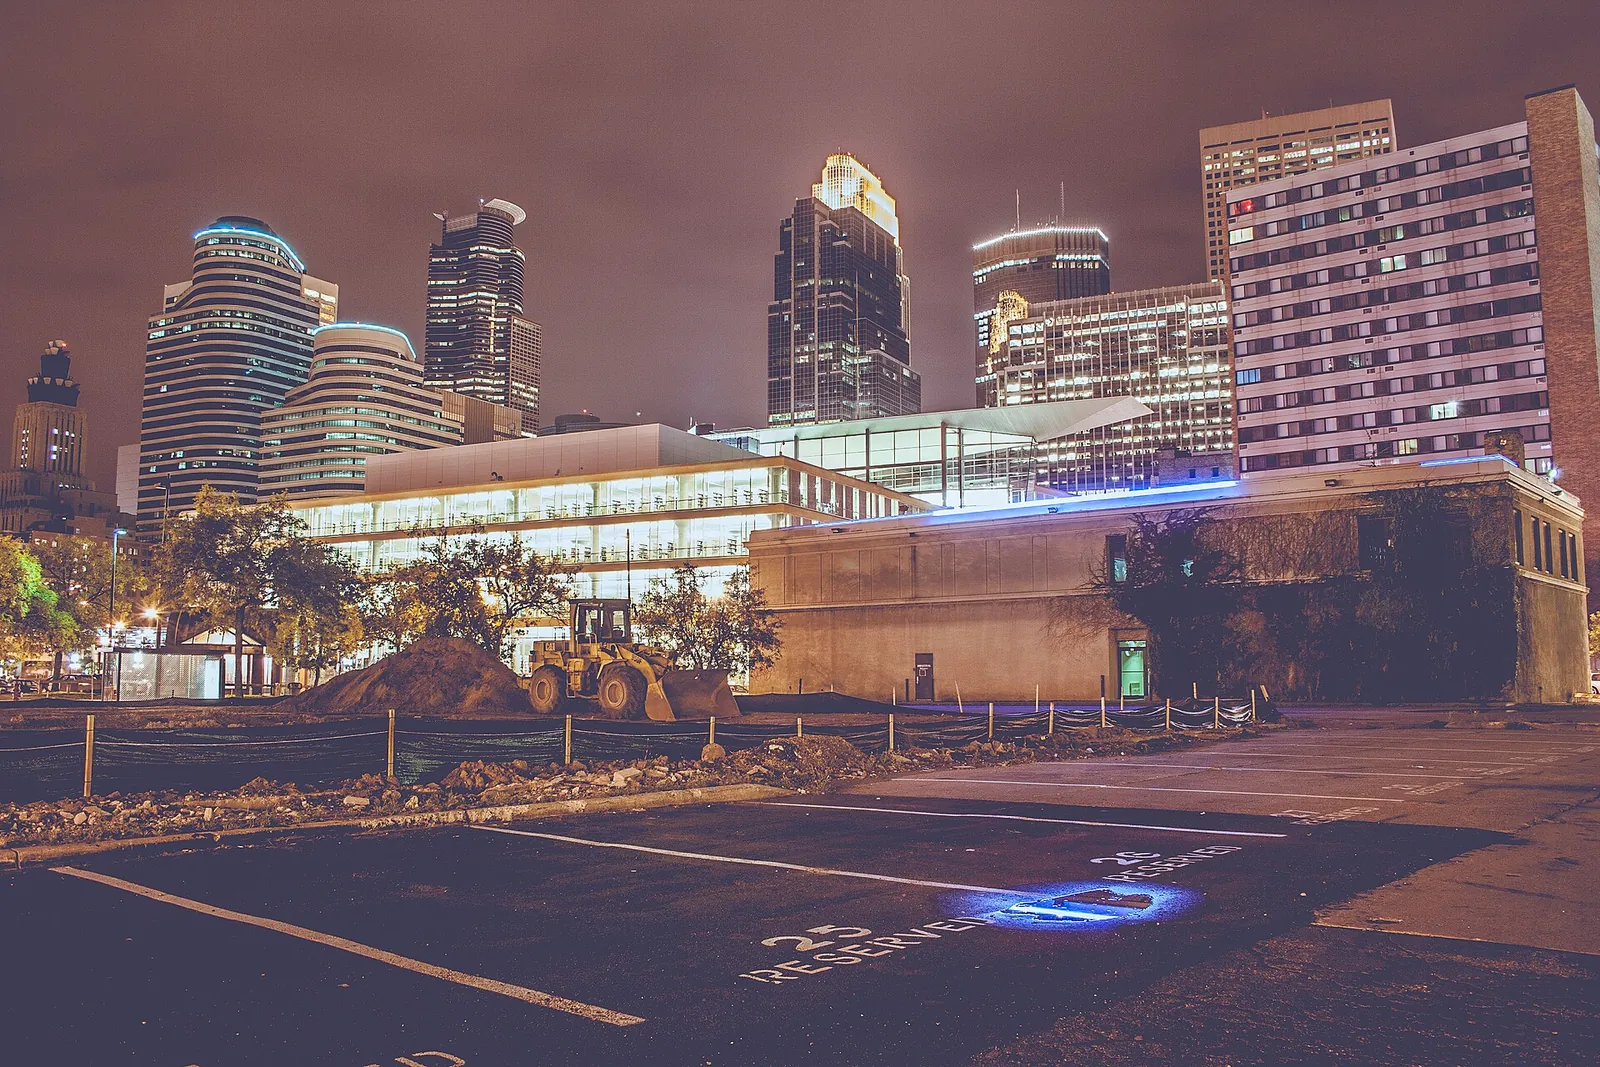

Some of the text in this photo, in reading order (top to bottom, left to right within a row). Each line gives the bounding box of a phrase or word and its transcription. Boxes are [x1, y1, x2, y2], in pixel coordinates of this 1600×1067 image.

[1090, 851, 1161, 866] 26
[1102, 845, 1242, 882] RESERVED
[739, 916, 994, 984] RESERVED
[761, 924, 872, 951] 25
